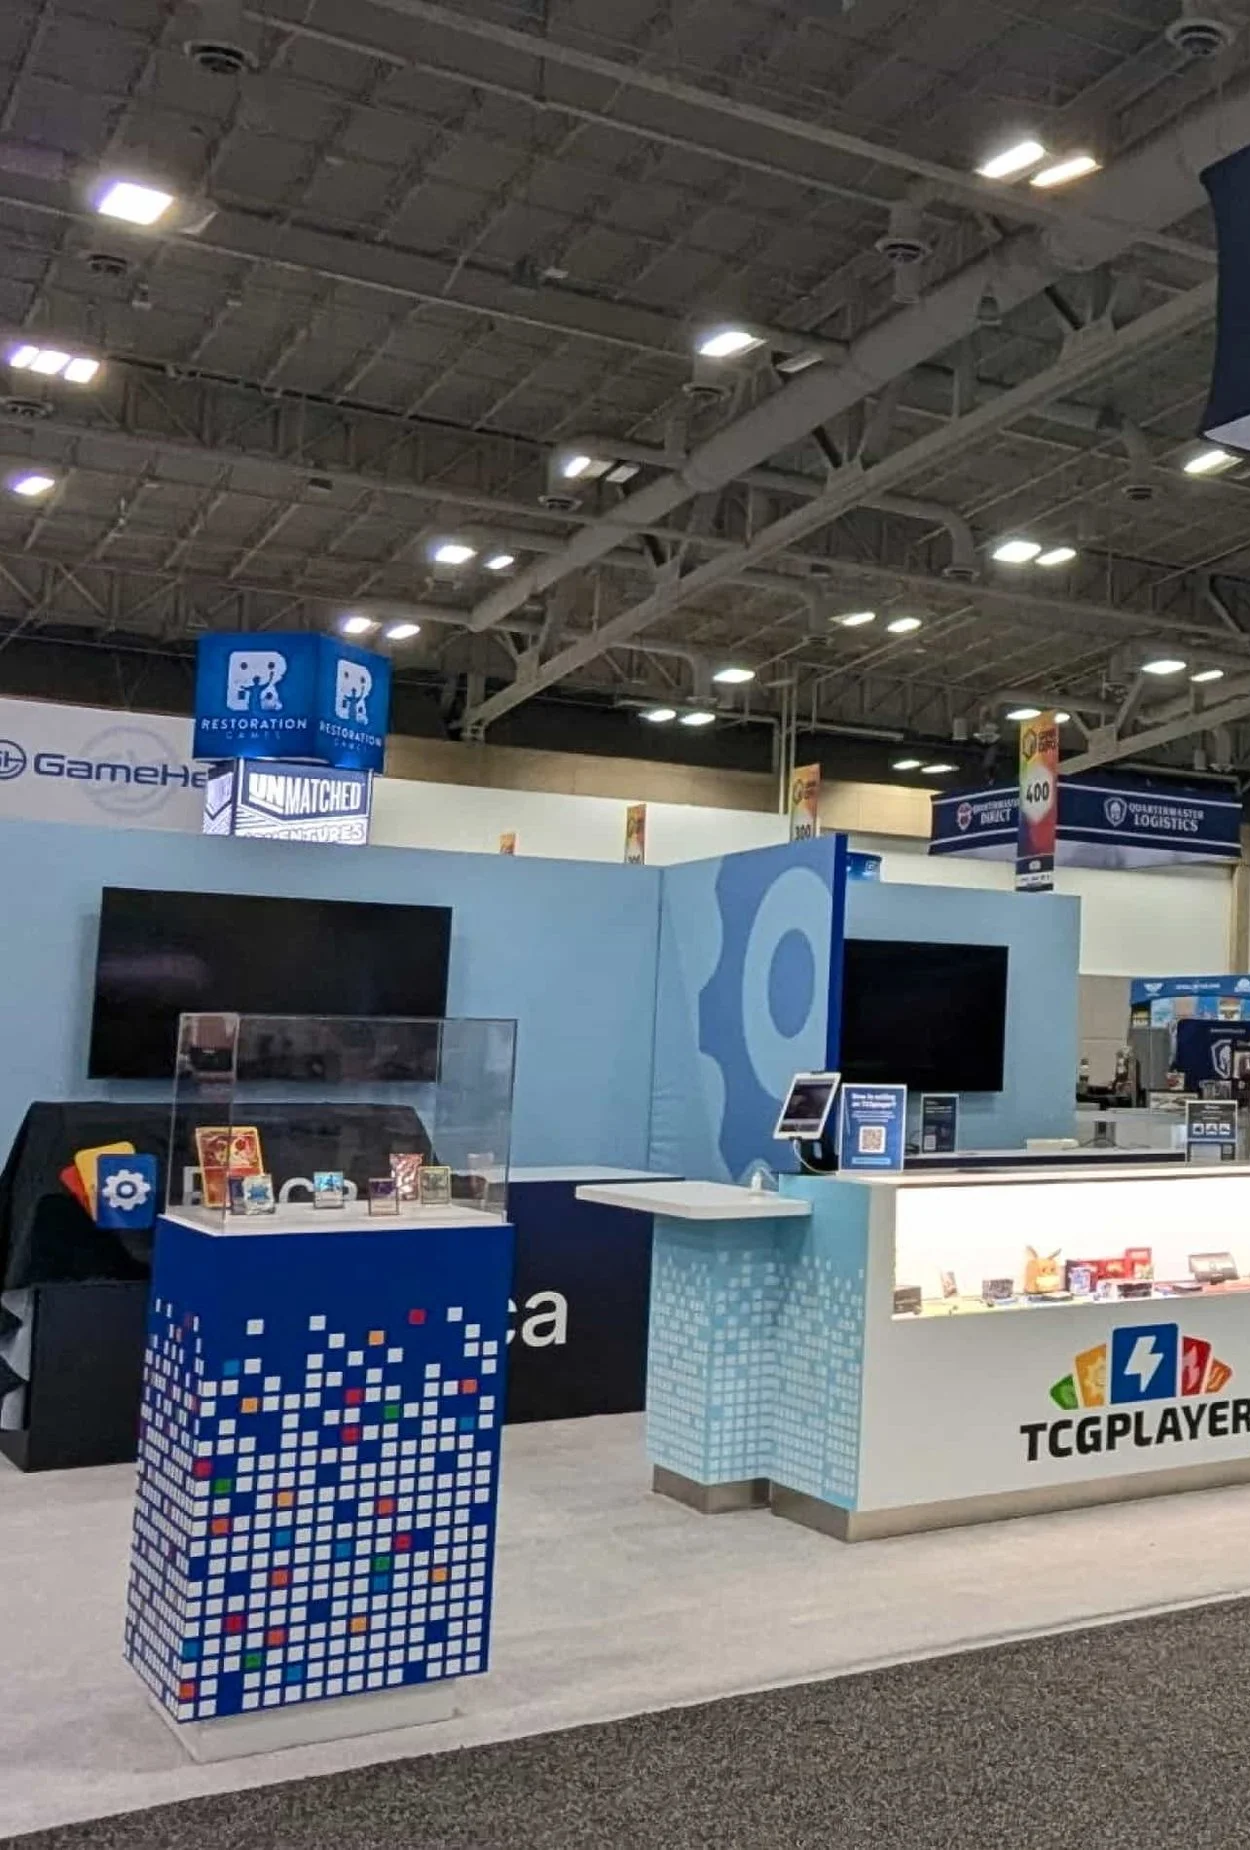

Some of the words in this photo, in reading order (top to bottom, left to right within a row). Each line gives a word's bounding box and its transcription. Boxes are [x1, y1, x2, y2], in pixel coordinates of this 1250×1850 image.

[201, 718, 307, 730] RESTORATION
[319, 724, 383, 748] RESTORATION
[34, 752, 208, 788] GameHe
[249, 773, 361, 815] UNMATCHED
[1026, 781, 1050, 803] 400
[1129, 802, 1204, 820] QUARTERMASTER
[1134, 814, 1199, 832] LOGISTICS
